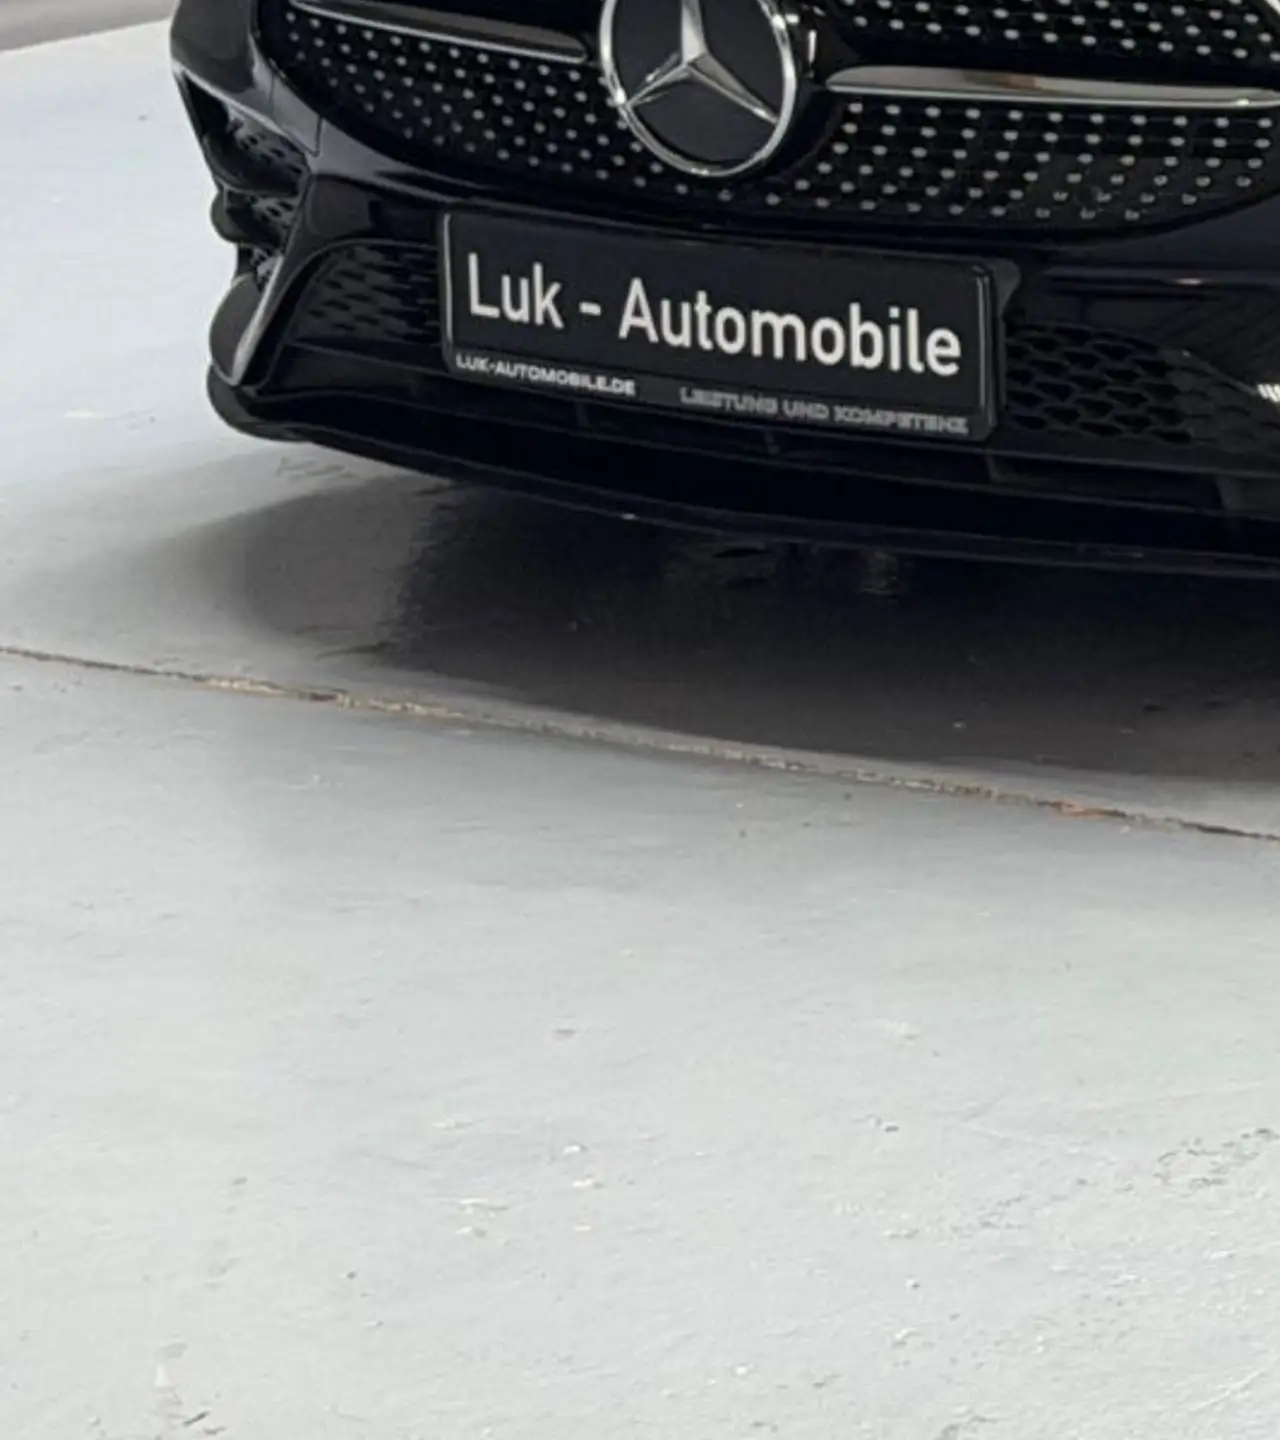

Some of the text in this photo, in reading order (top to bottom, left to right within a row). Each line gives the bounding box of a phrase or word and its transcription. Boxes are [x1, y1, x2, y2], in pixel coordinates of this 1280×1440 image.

[467, 252, 962, 376] Luk - Automobile
[455, 353, 636, 397] LUK-AUTOMOBILE.DE
[783, 399, 830, 421] UND
